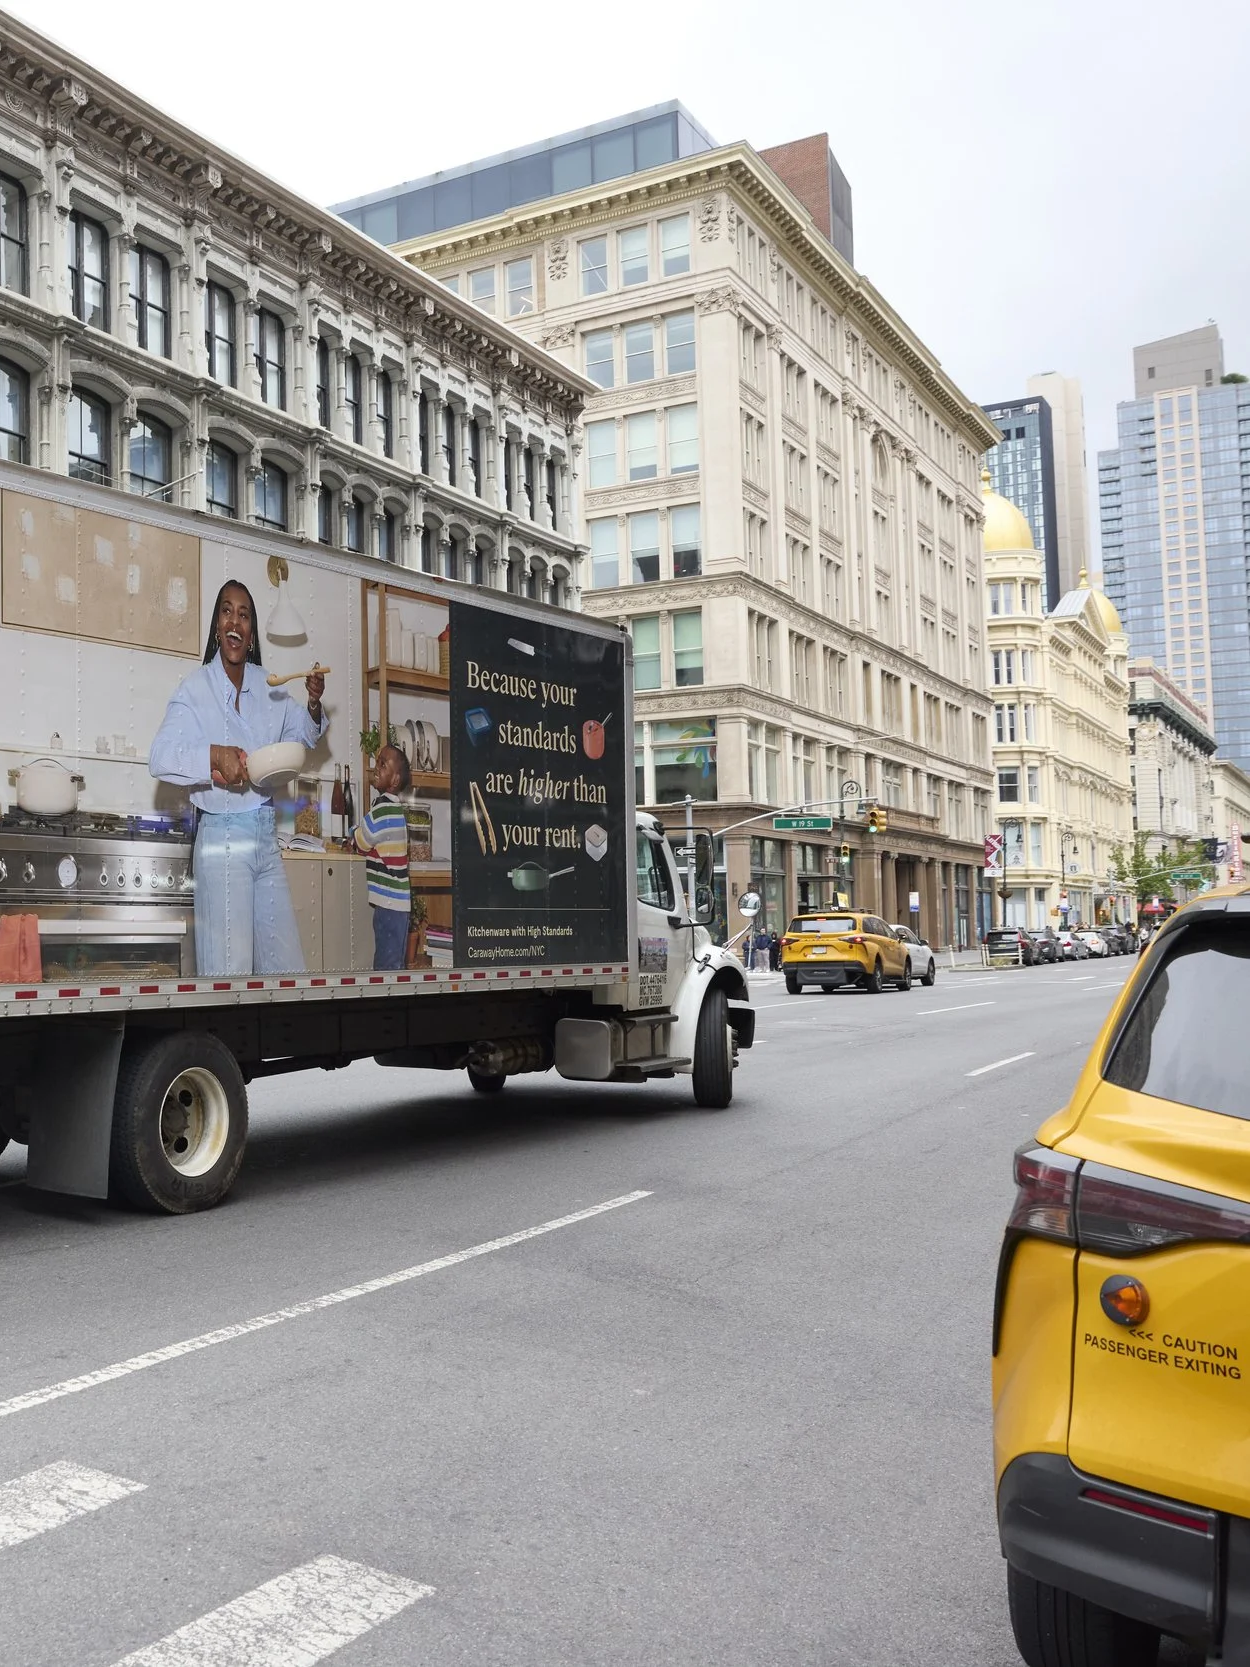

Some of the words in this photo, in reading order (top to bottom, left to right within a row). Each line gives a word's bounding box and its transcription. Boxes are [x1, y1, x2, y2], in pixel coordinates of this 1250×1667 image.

[466, 660, 537, 700] Because
[540, 681, 577, 708] your
[498, 720, 577, 754] standards
[485, 771, 514, 795] are
[517, 768, 570, 805] higher
[573, 774, 607, 804] than
[502, 823, 540, 851] your
[545, 824, 581, 849] rent.
[791, 820, 797, 828] W
[799, 820, 805, 828] 19
[806, 820, 814, 828] St
[467, 926, 510, 937] Kitchenware
[511, 925, 526, 936] with
[527, 925, 541, 938] High
[542, 925, 573, 936] Standards
[467, 945, 545, 960] CarawayHome.com/NYC
[1084, 1333, 1169, 1365] PASSENGER
[1174, 1355, 1242, 1379] EXITING
[1162, 1334, 1238, 1360] CAUTION
